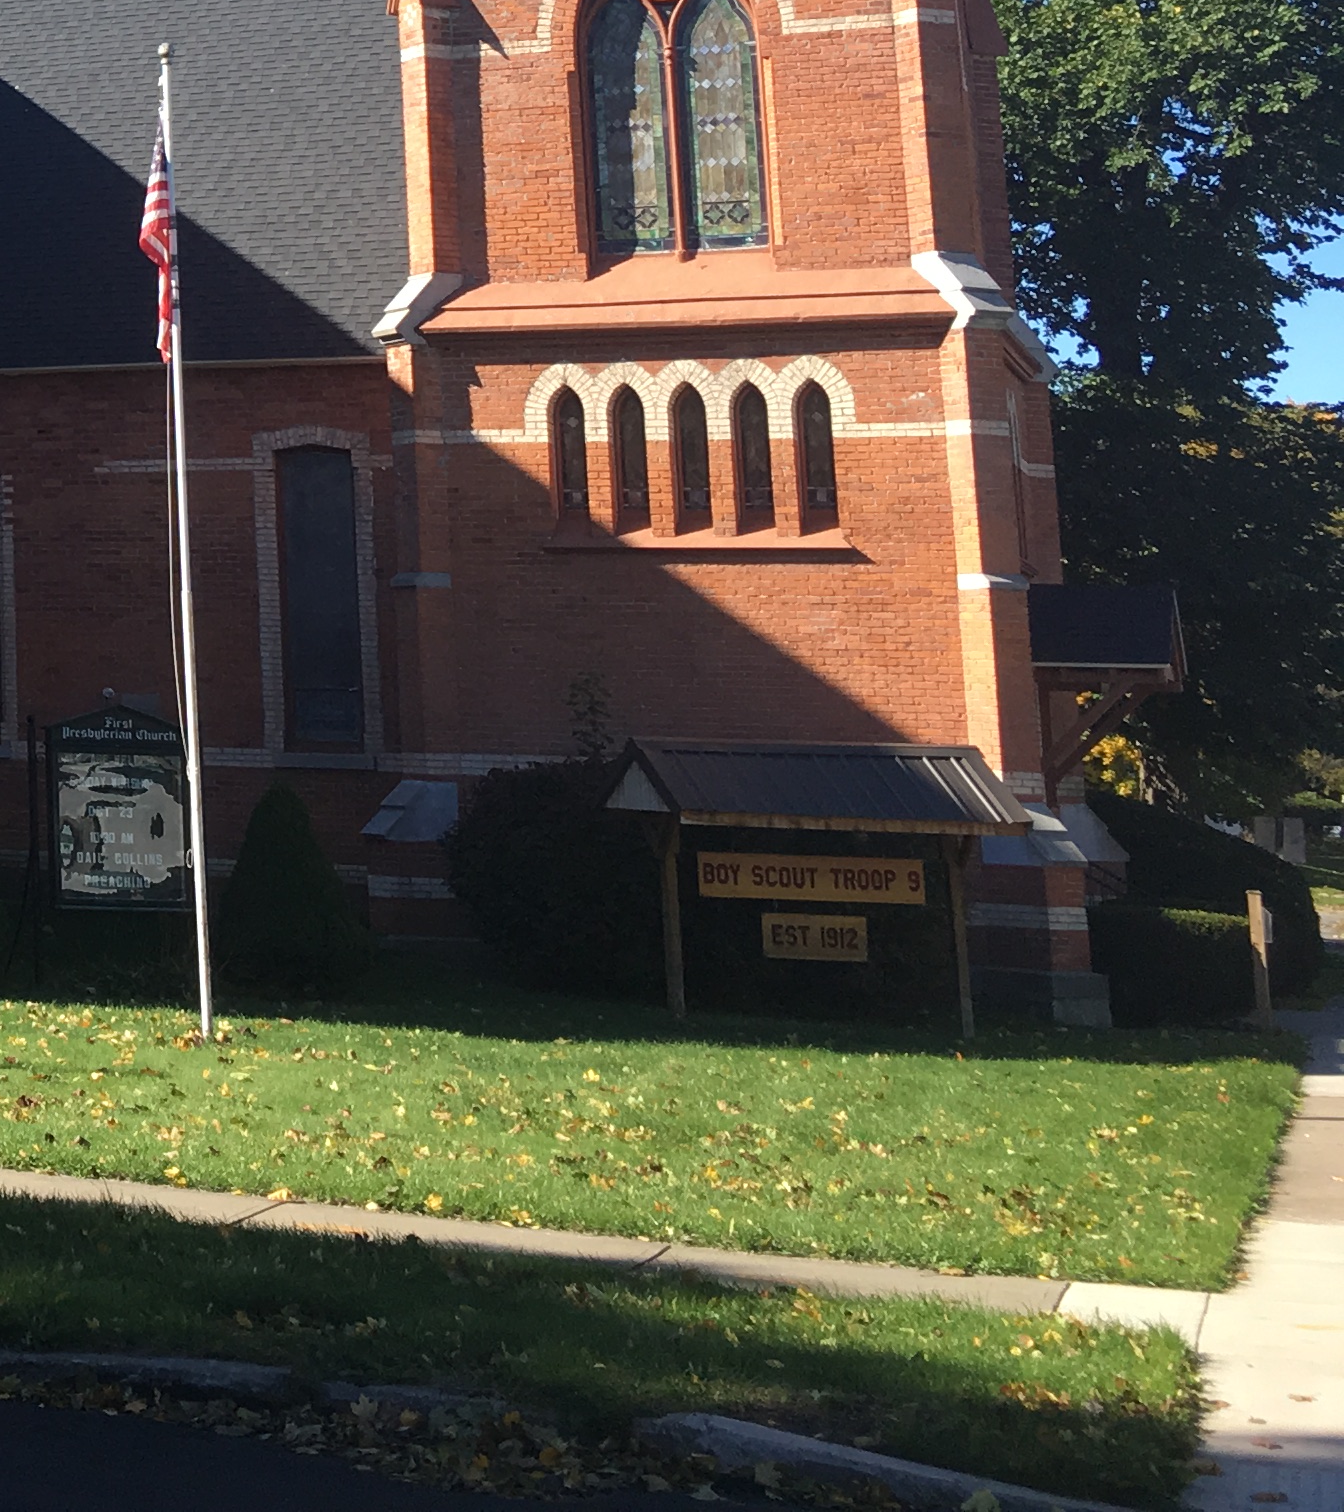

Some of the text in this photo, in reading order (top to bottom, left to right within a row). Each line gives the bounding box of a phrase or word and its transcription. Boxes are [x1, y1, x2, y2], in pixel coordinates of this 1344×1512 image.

[104, 716, 133, 729] First
[62, 726, 177, 742] Presbyterian Church
[69, 776, 105, 787] SDAY
[88, 805, 133, 818] OCT 23
[120, 832, 134, 844] AM
[114, 852, 163, 866] COLLINS
[84, 874, 151, 889] PREACHING
[702, 862, 741, 886] BOY
[752, 865, 818, 889] SCOUT
[830, 867, 897, 891] TROOP
[771, 923, 859, 951] EST 1912
